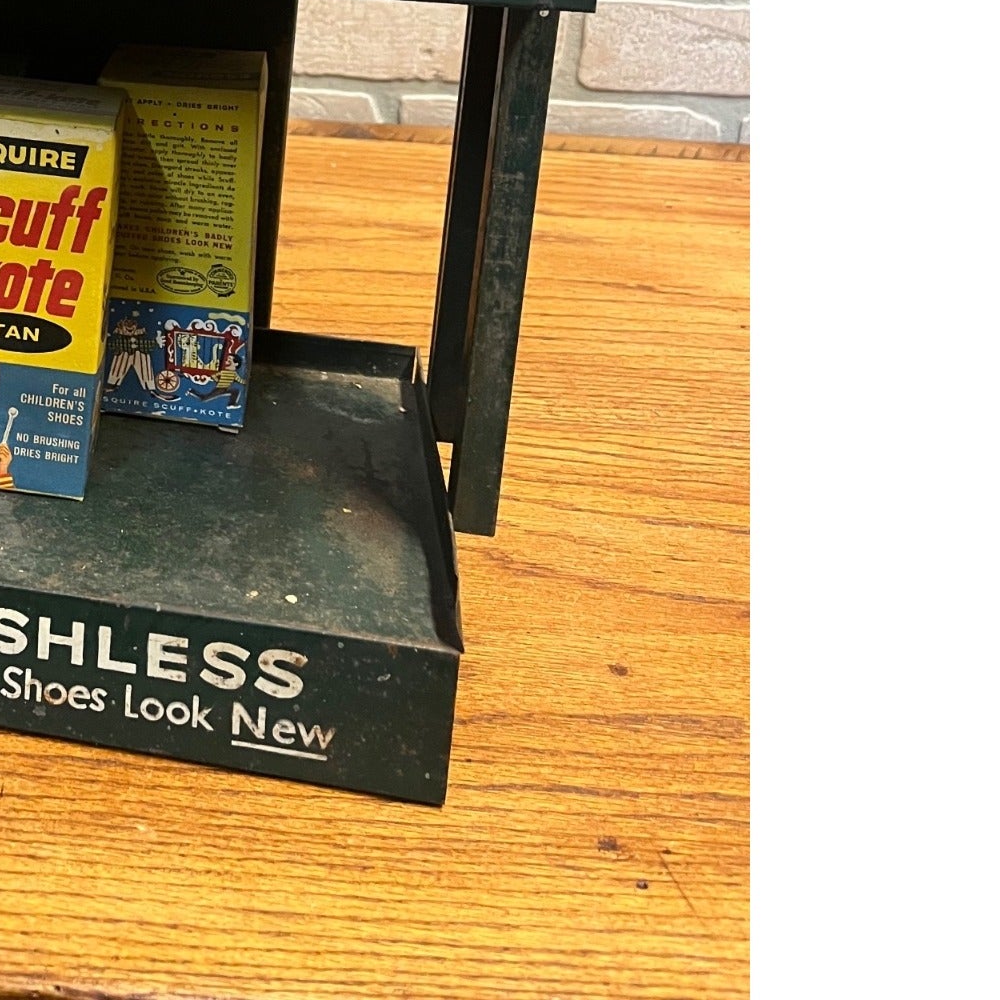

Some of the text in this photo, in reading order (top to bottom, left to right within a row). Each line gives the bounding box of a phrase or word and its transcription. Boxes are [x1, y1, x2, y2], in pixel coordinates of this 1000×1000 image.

[185, 238, 209, 248] LOOK
[213, 241, 232, 250] NEW
[205, 232, 233, 241] BADLY
[52, 383, 86, 398] For all
[20, 392, 85, 412] CHILDREN'S
[47, 410, 83, 426] SHOES
[16, 433, 80, 450] NO BRUSHING
[13, 447, 79, 464] DRIES BRIGHT
[0, 666, 107, 712] Shoes
[124, 685, 214, 732] Look
[232, 702, 336, 750] New
